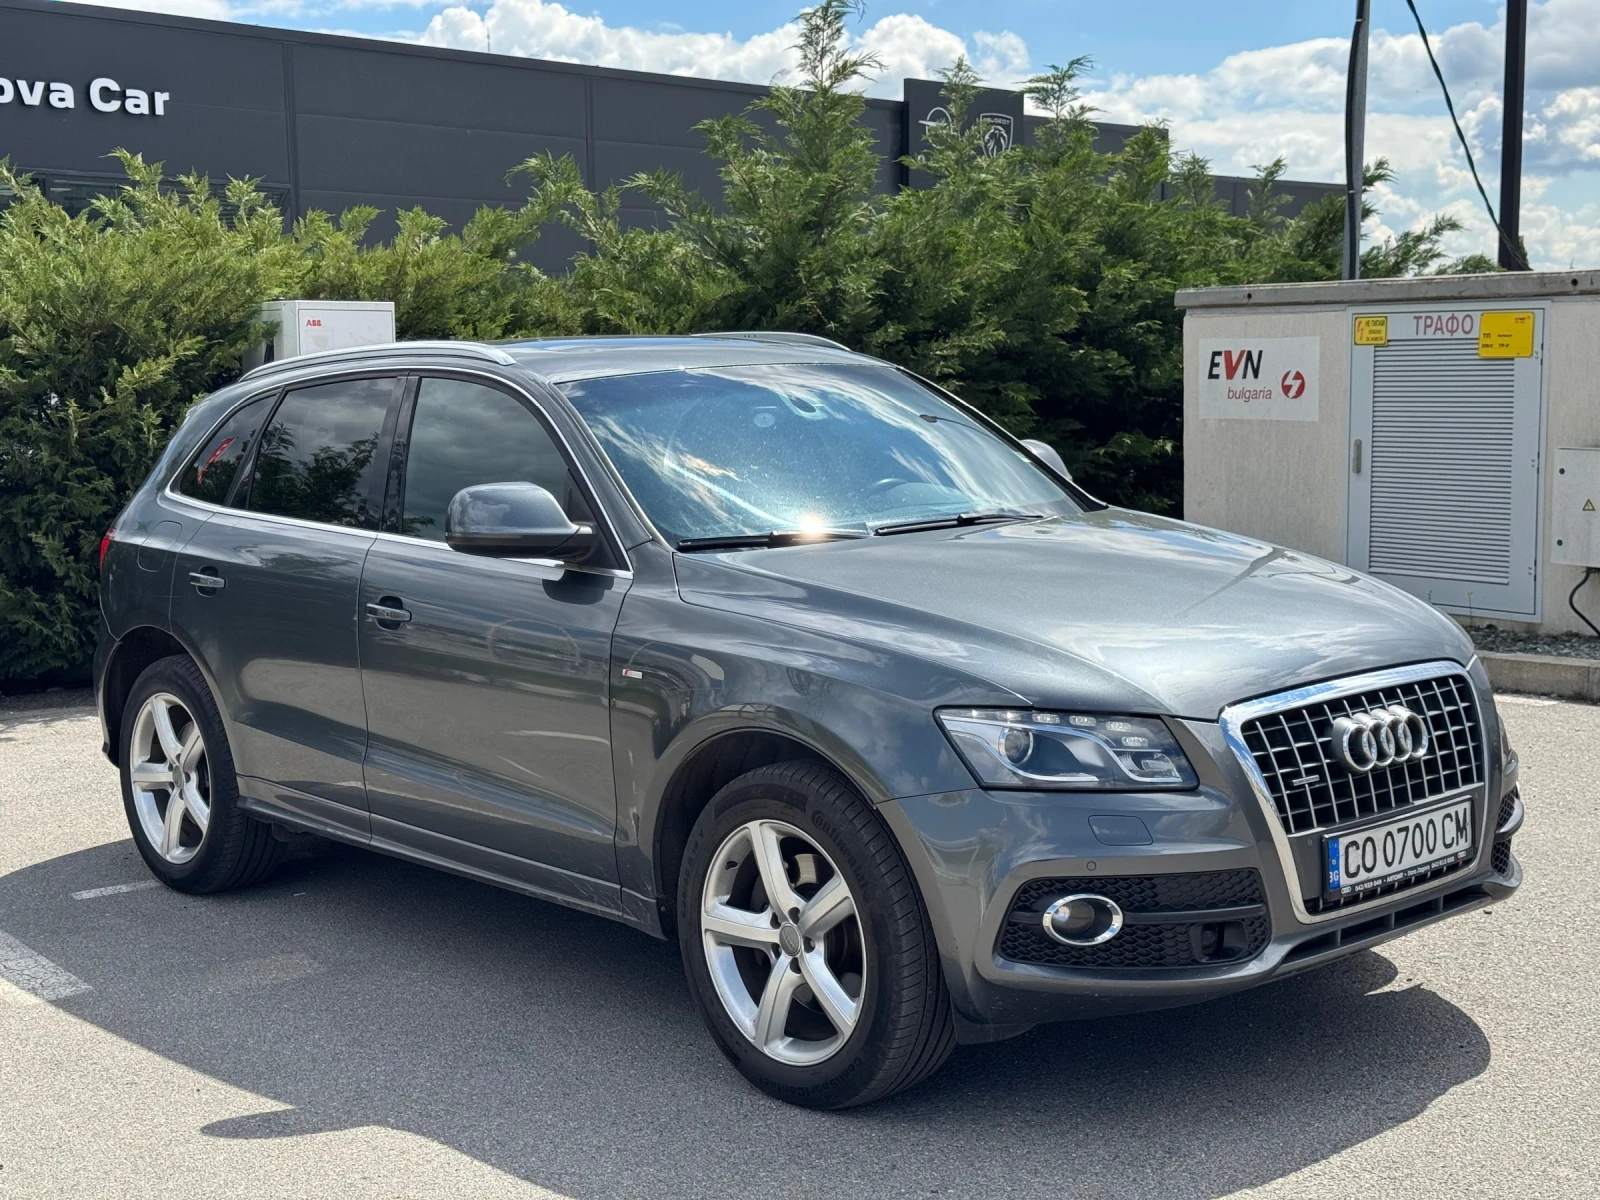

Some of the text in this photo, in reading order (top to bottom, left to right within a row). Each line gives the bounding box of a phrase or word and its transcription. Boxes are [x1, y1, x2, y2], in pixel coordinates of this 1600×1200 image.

[89, 77, 170, 116] Car
[306, 319, 322, 327] ABB
[1413, 313, 1474, 337] ТРАФО
[1207, 349, 1264, 381] EVN
[1227, 386, 1273, 403] bulgaria
[811, 808, 870, 891] Continental
[1344, 807, 1468, 879] CO 0700 CM
